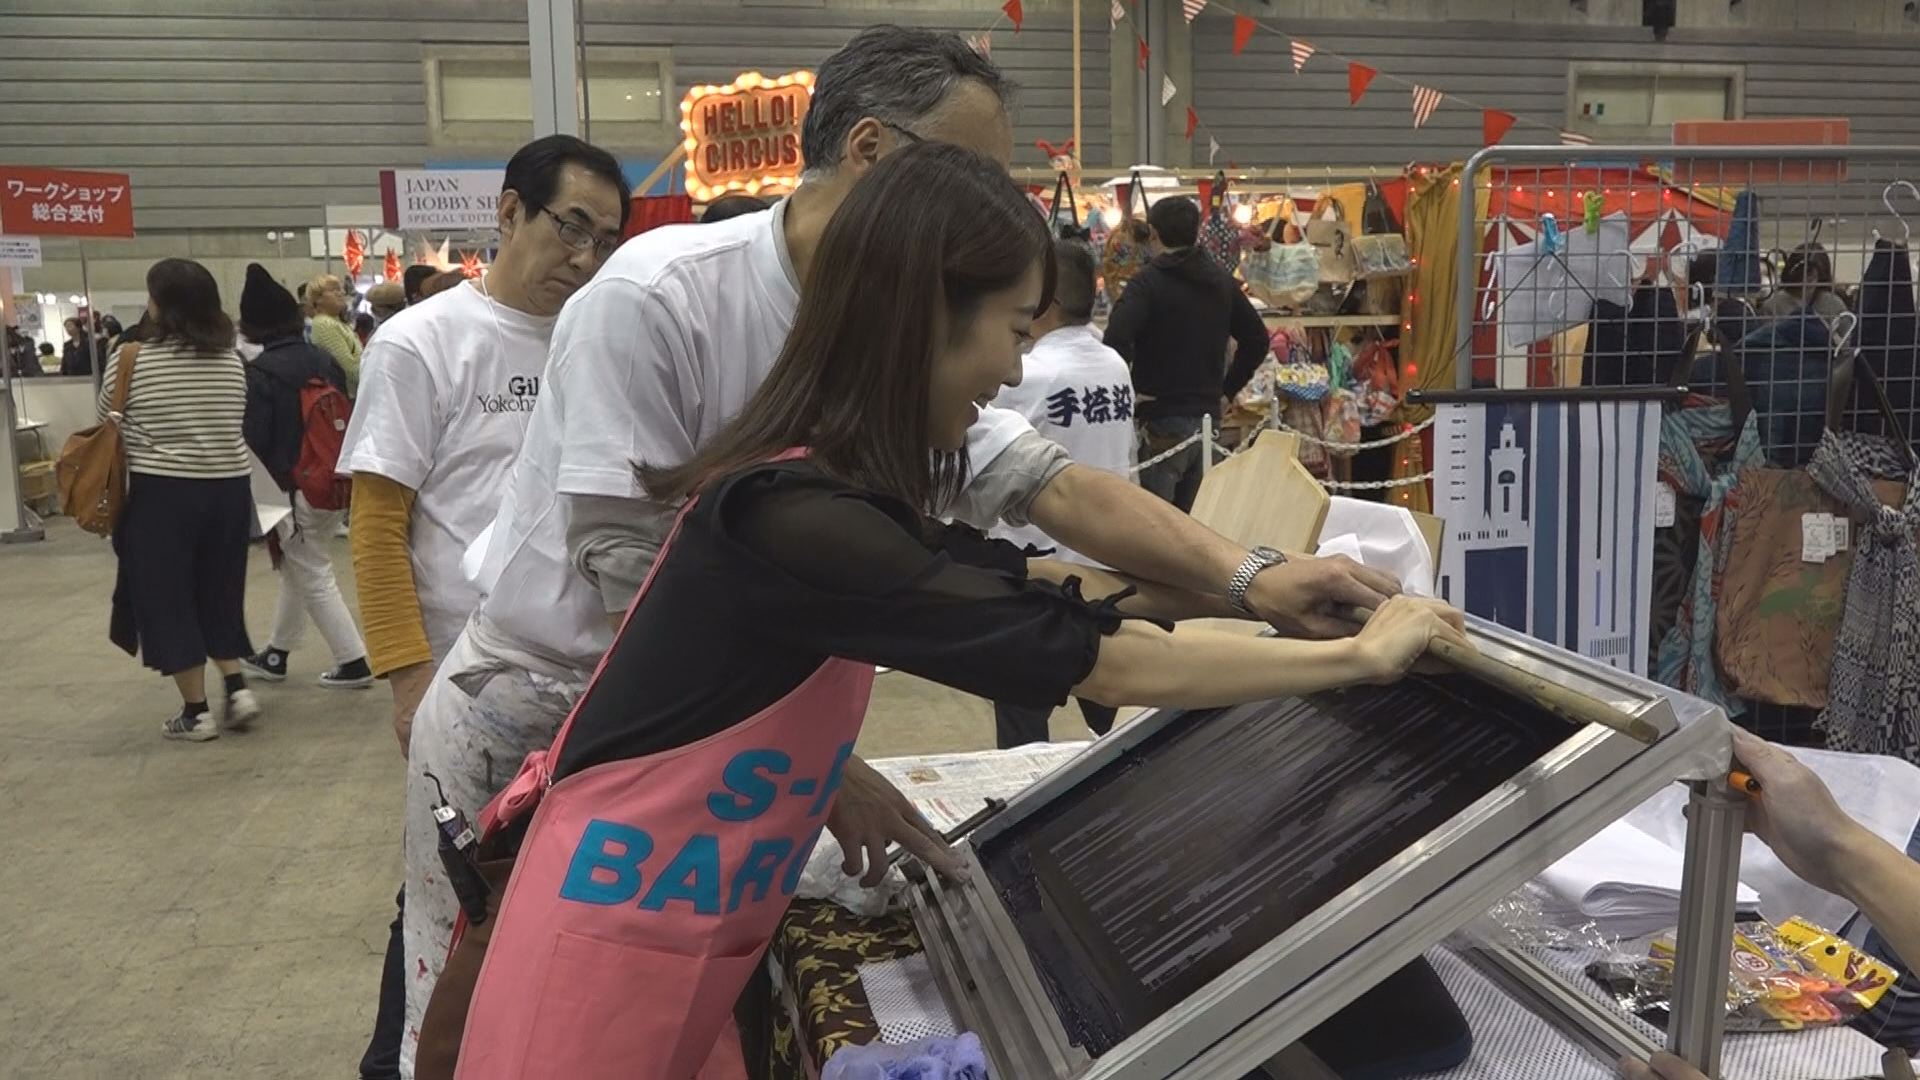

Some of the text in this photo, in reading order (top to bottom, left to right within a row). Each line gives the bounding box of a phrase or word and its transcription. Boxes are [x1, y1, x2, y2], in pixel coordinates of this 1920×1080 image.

[703, 93, 797, 136] HELLO!
[705, 133, 798, 173] CIRCUS
[7, 180, 124, 203] ワークショップ
[405, 178, 459, 194] JAPAN
[31, 202, 104, 223] 総合受付
[407, 195, 473, 211] HOBBY
[408, 213, 454, 224] SPECIAL
